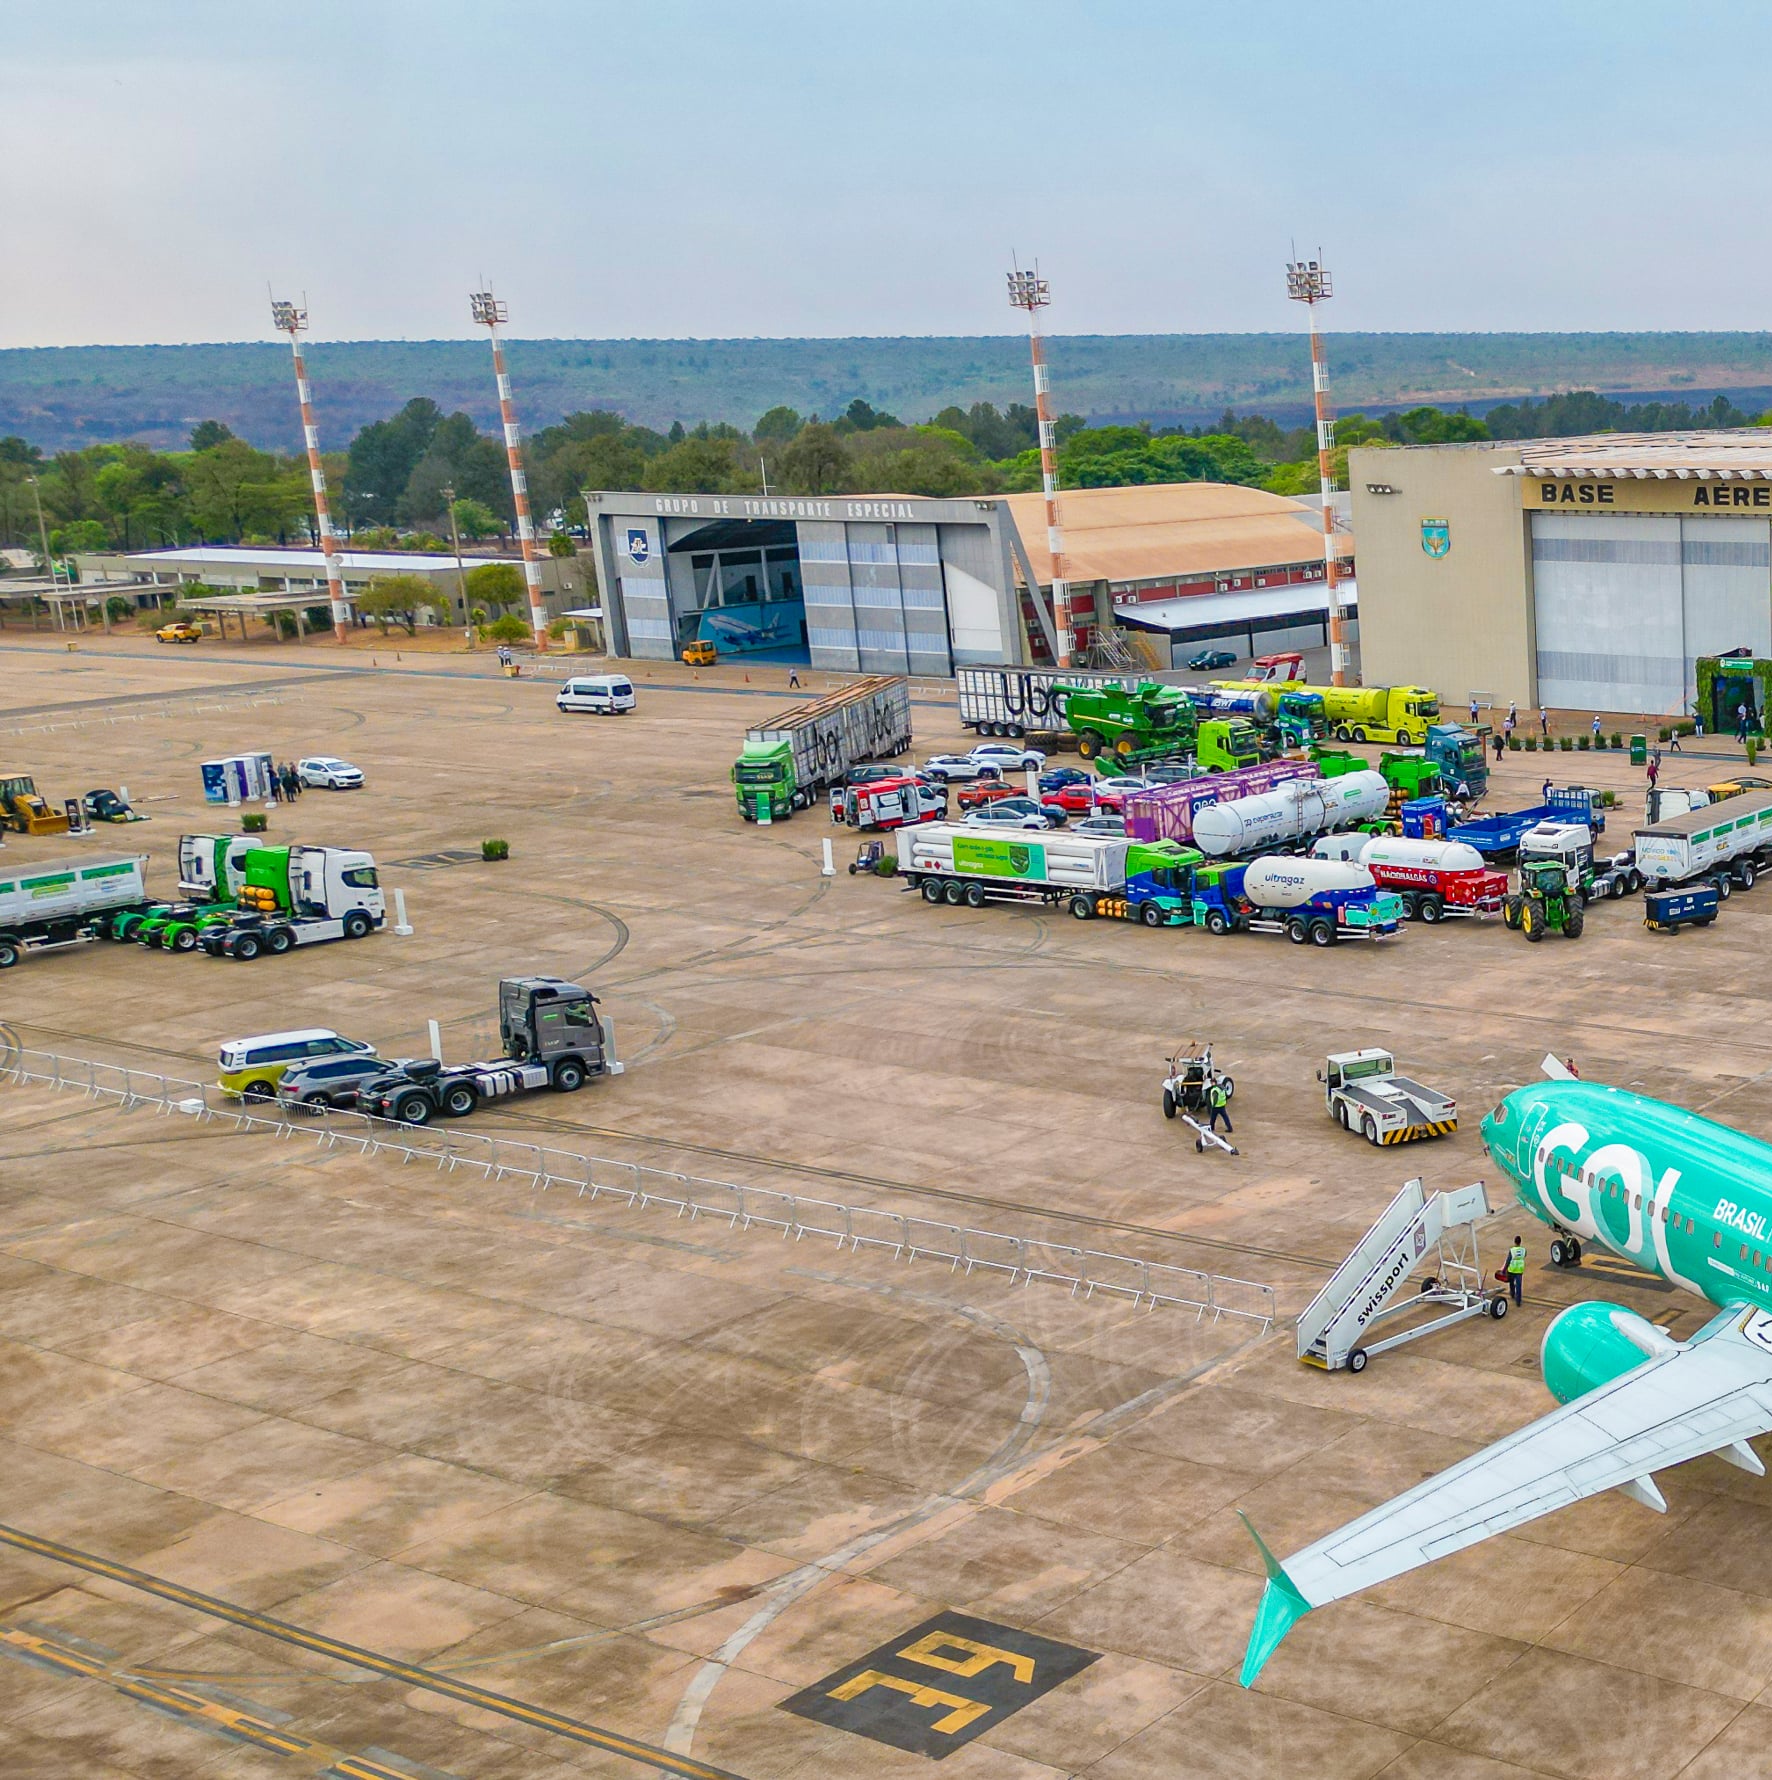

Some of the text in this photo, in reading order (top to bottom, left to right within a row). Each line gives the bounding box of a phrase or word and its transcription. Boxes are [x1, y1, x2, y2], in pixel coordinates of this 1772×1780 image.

[655, 498, 915, 519] GRUPO DE TRANSPORTE ESPECIAL
[1540, 483, 1615, 504] BASE
[1264, 873, 1306, 886] ultragaz
[1534, 1120, 1709, 1302] GOL
[1712, 1197, 1767, 1241] BRASIL
[1357, 1252, 1410, 1326] swissport
